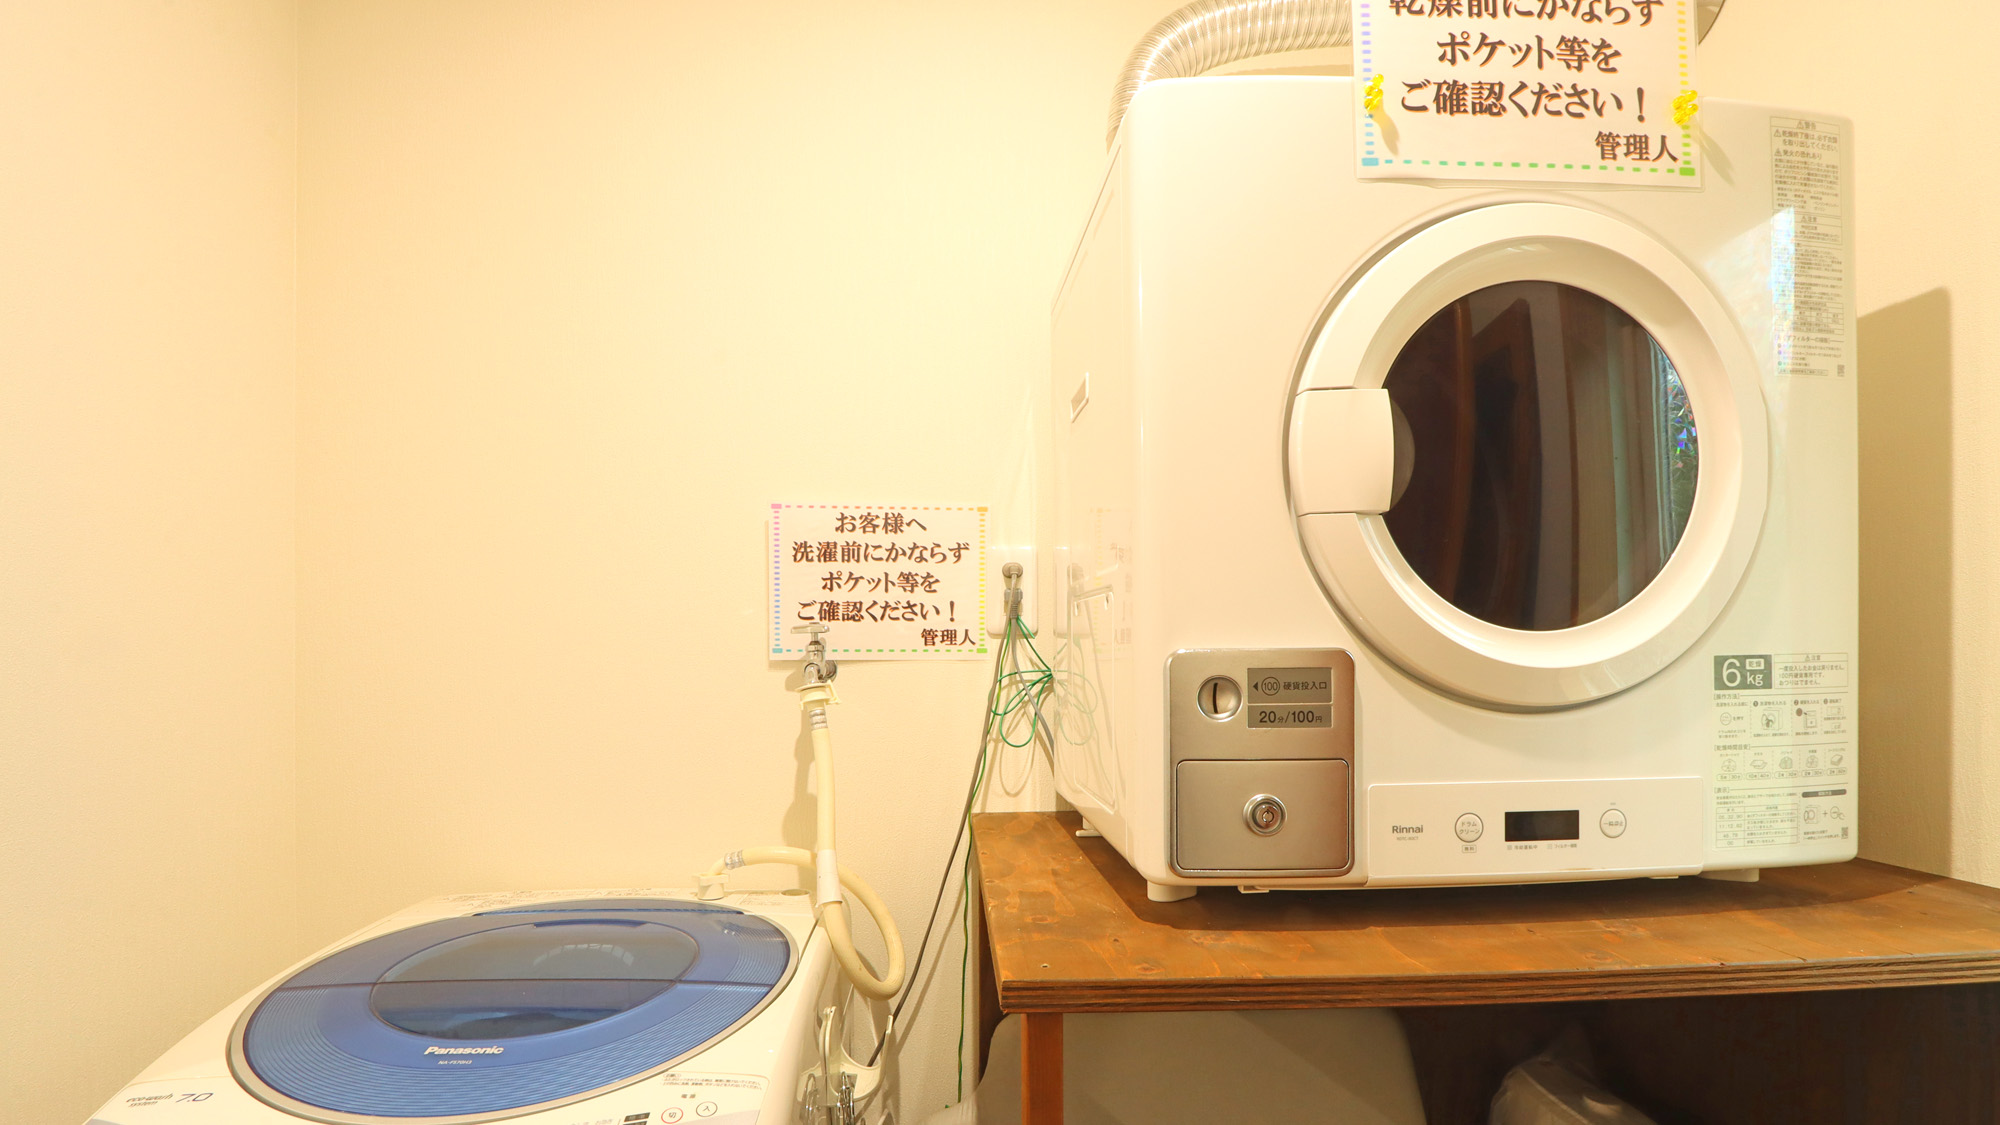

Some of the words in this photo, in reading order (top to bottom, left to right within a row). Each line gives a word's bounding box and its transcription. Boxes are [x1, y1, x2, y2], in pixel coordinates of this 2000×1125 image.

[1436, 31, 1624, 73] ポケット等を
[1401, 79, 1646, 123] ご確認ください！
[1595, 131, 1679, 163] 管理人
[835, 512, 927, 534] お客様へ
[792, 540, 970, 564] 洗濯前にかならず
[821, 571, 941, 593] ポケット等を
[797, 600, 955, 623] ご確認ください！
[921, 628, 976, 646] 管理人
[1722, 658, 1741, 687] 6
[1746, 672, 1764, 687] kg
[1263, 682, 1278, 691] 100
[1283, 681, 1327, 690] 硬貨投入口
[1392, 825, 1424, 834] Rinnai
[424, 1045, 504, 1056] Panasonic
[175, 1092, 214, 1103] 7.0
